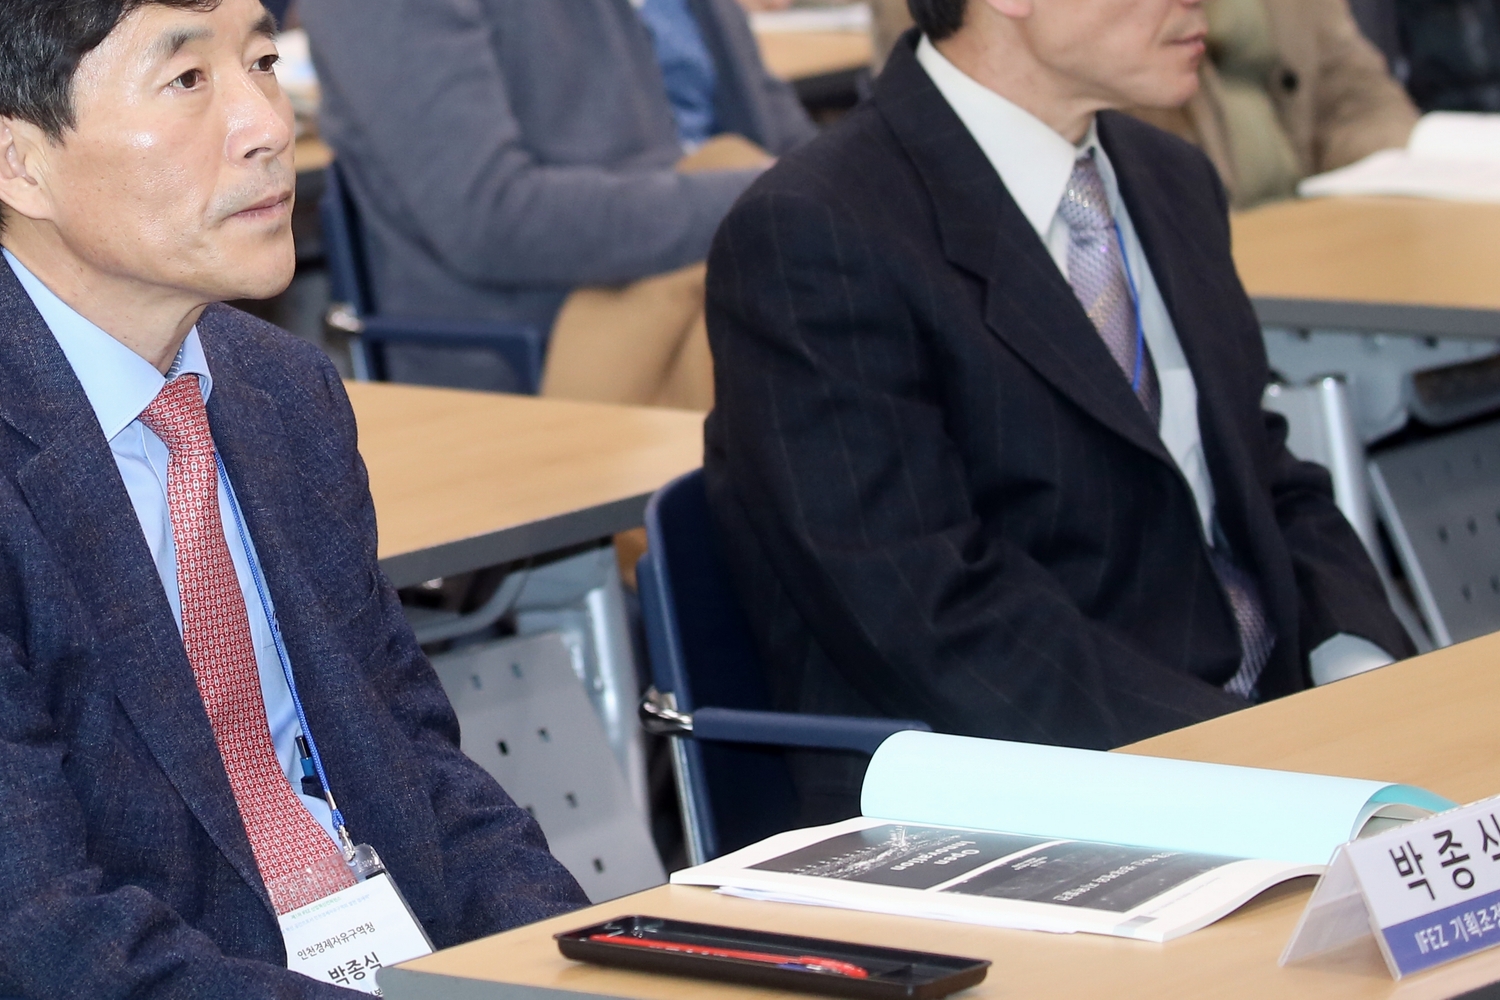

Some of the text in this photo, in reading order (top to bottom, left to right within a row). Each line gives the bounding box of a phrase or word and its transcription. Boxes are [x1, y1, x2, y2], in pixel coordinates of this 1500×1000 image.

[889, 840, 977, 871] Innovation
[933, 848, 981, 866] Open
[297, 921, 376, 961] 인천경제자유구역청
[1414, 923, 1449, 954] IFEZ
[327, 951, 384, 985] 박종식
